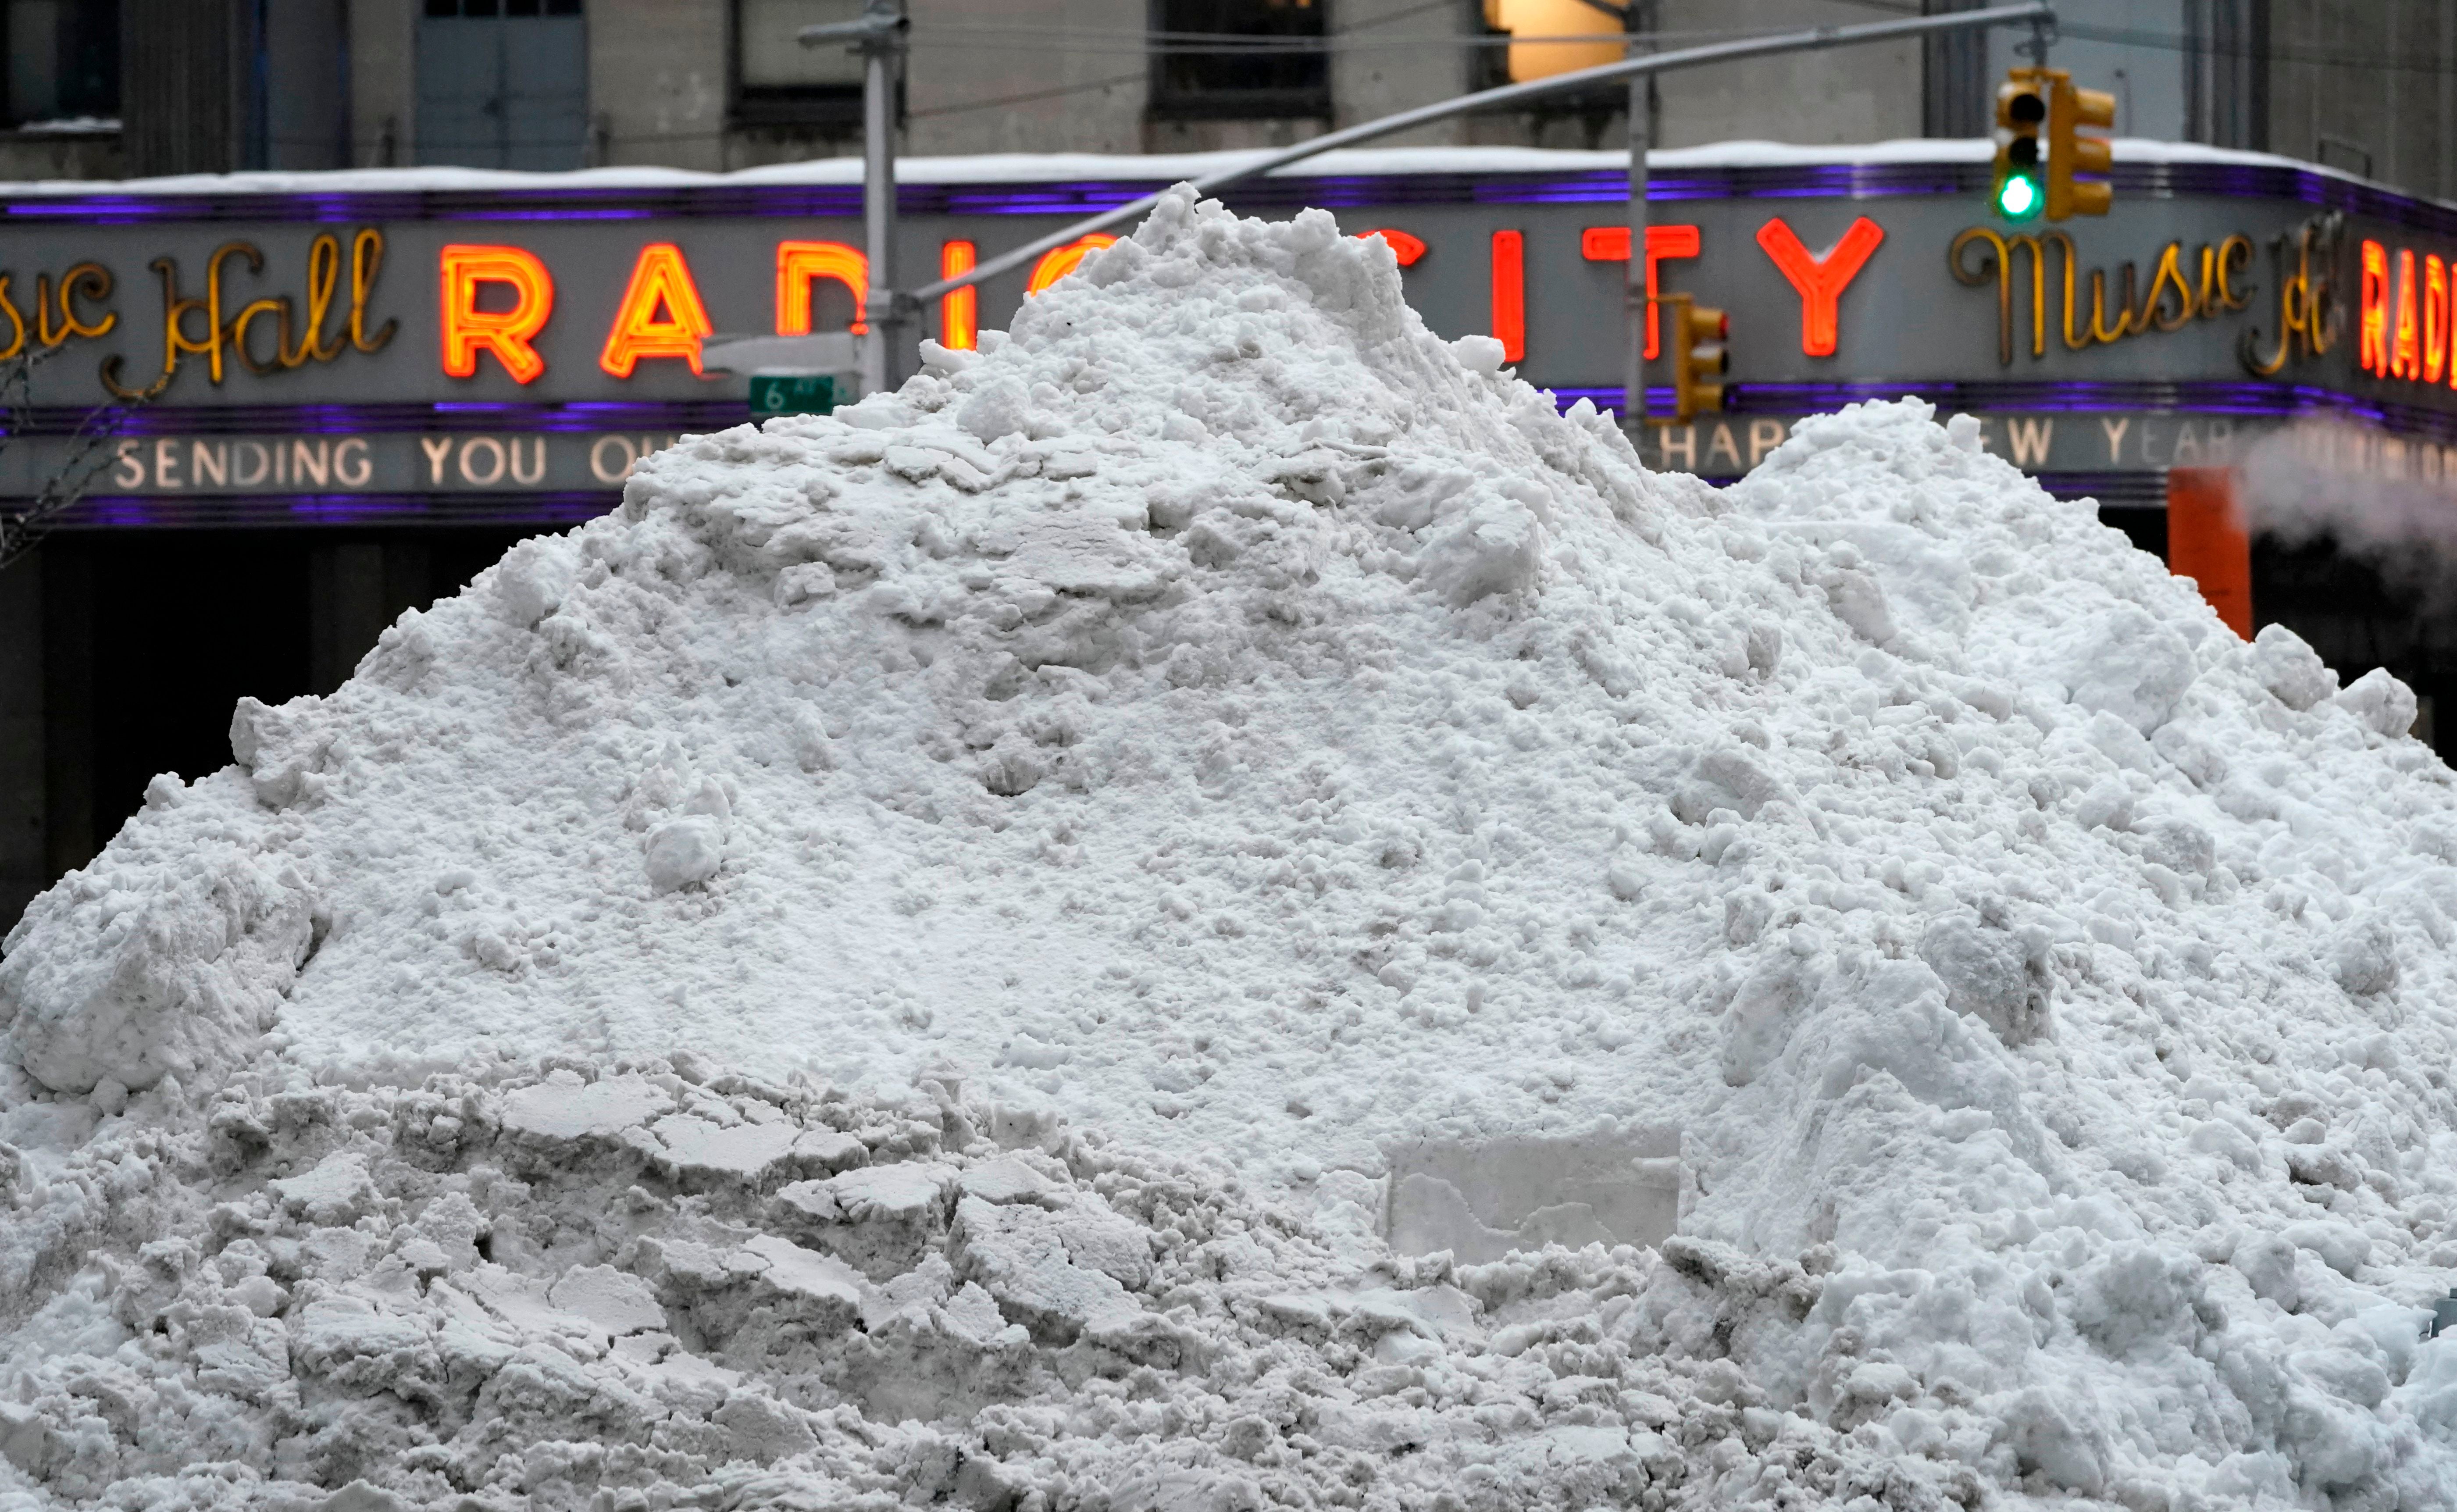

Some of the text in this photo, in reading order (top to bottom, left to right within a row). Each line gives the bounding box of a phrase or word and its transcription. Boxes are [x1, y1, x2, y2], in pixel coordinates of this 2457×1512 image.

[100, 228, 401, 400] Hall
[441, 216, 1885, 384] RADI ITY
[1951, 227, 2257, 365] Music
[114, 439, 373, 488] SENDING
[421, 435, 546, 485] YOU
[766, 381, 785, 410] 6
